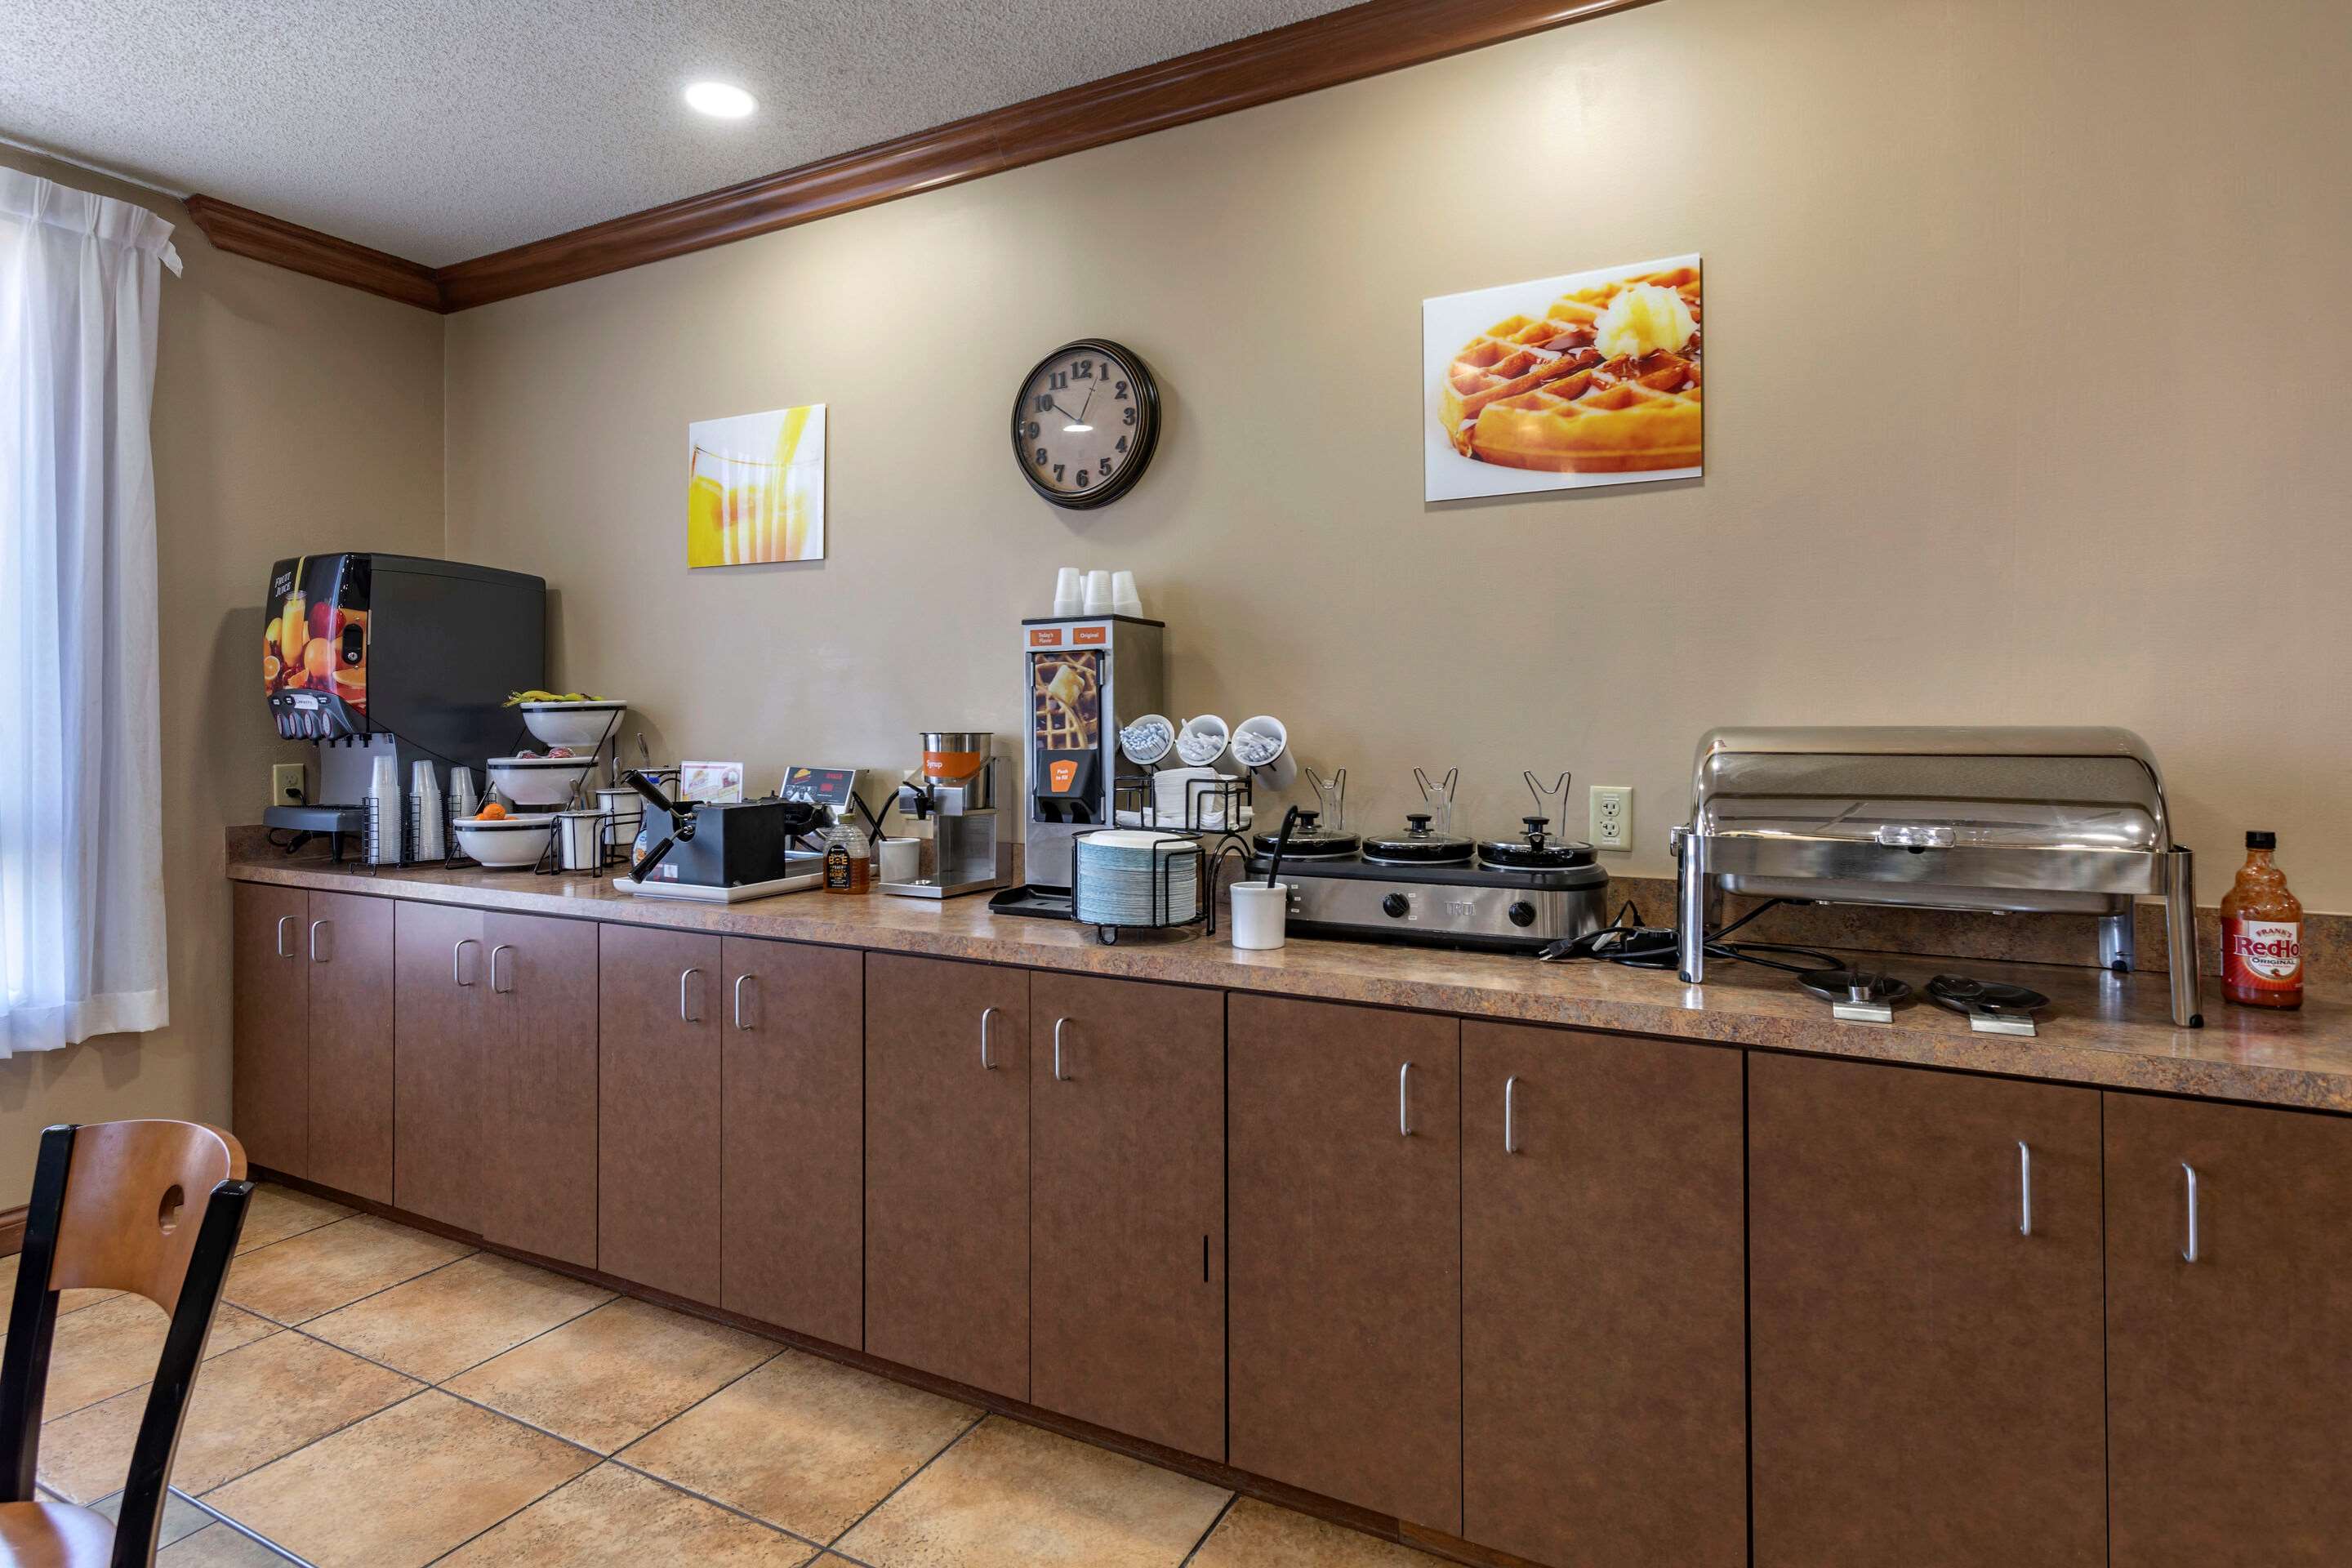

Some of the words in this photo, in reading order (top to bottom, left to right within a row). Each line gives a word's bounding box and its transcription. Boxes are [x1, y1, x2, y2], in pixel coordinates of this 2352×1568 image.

[1071, 360, 1093, 380] 12
[1099, 363, 1109, 381] 1
[1049, 372, 1068, 390] 11
[1115, 381, 1127, 399] 2
[1033, 394, 1054, 412] 10
[1123, 408, 1135, 425] 3
[1027, 421, 1040, 439] 9
[1116, 435, 1127, 453] 4
[1036, 448, 1047, 466] 8
[1054, 464, 1065, 482] 7
[1098, 457, 1111, 476] 5
[1076, 470, 1089, 488] 6
[926, 760, 942, 768] Syrup
[2256, 928, 2293, 938] FRANK'S
[2233, 934, 2301, 959] RedHo
[2252, 957, 2296, 965] ORIGINAL
